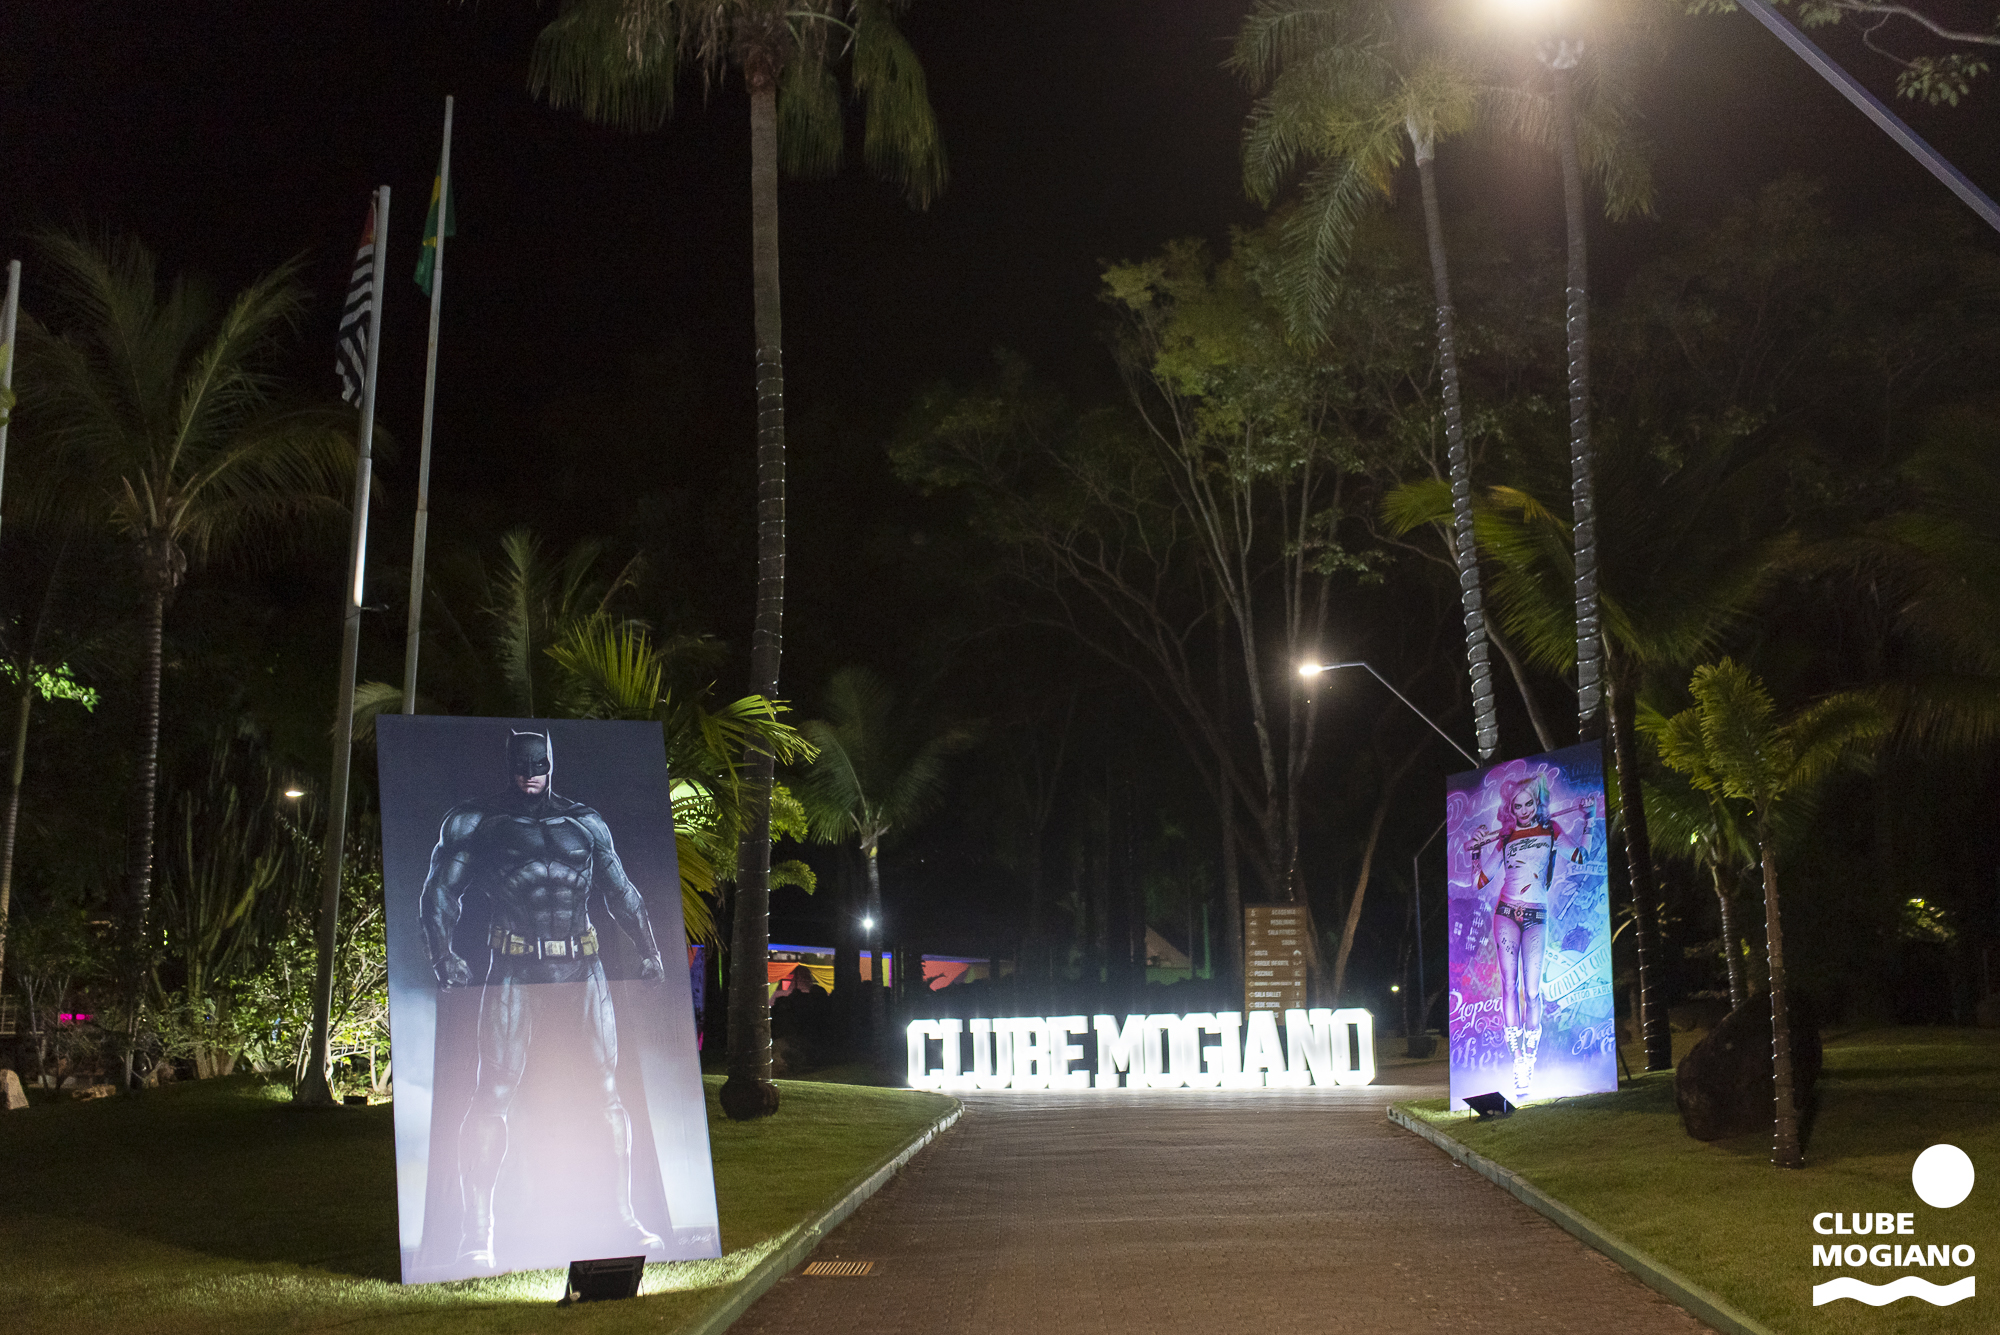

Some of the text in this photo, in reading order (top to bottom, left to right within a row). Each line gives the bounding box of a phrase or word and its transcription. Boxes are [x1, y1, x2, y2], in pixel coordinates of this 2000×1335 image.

[1565, 989, 1590, 1005] TATTOO
[906, 1007, 1376, 1089] CLUBE MOGIANO
